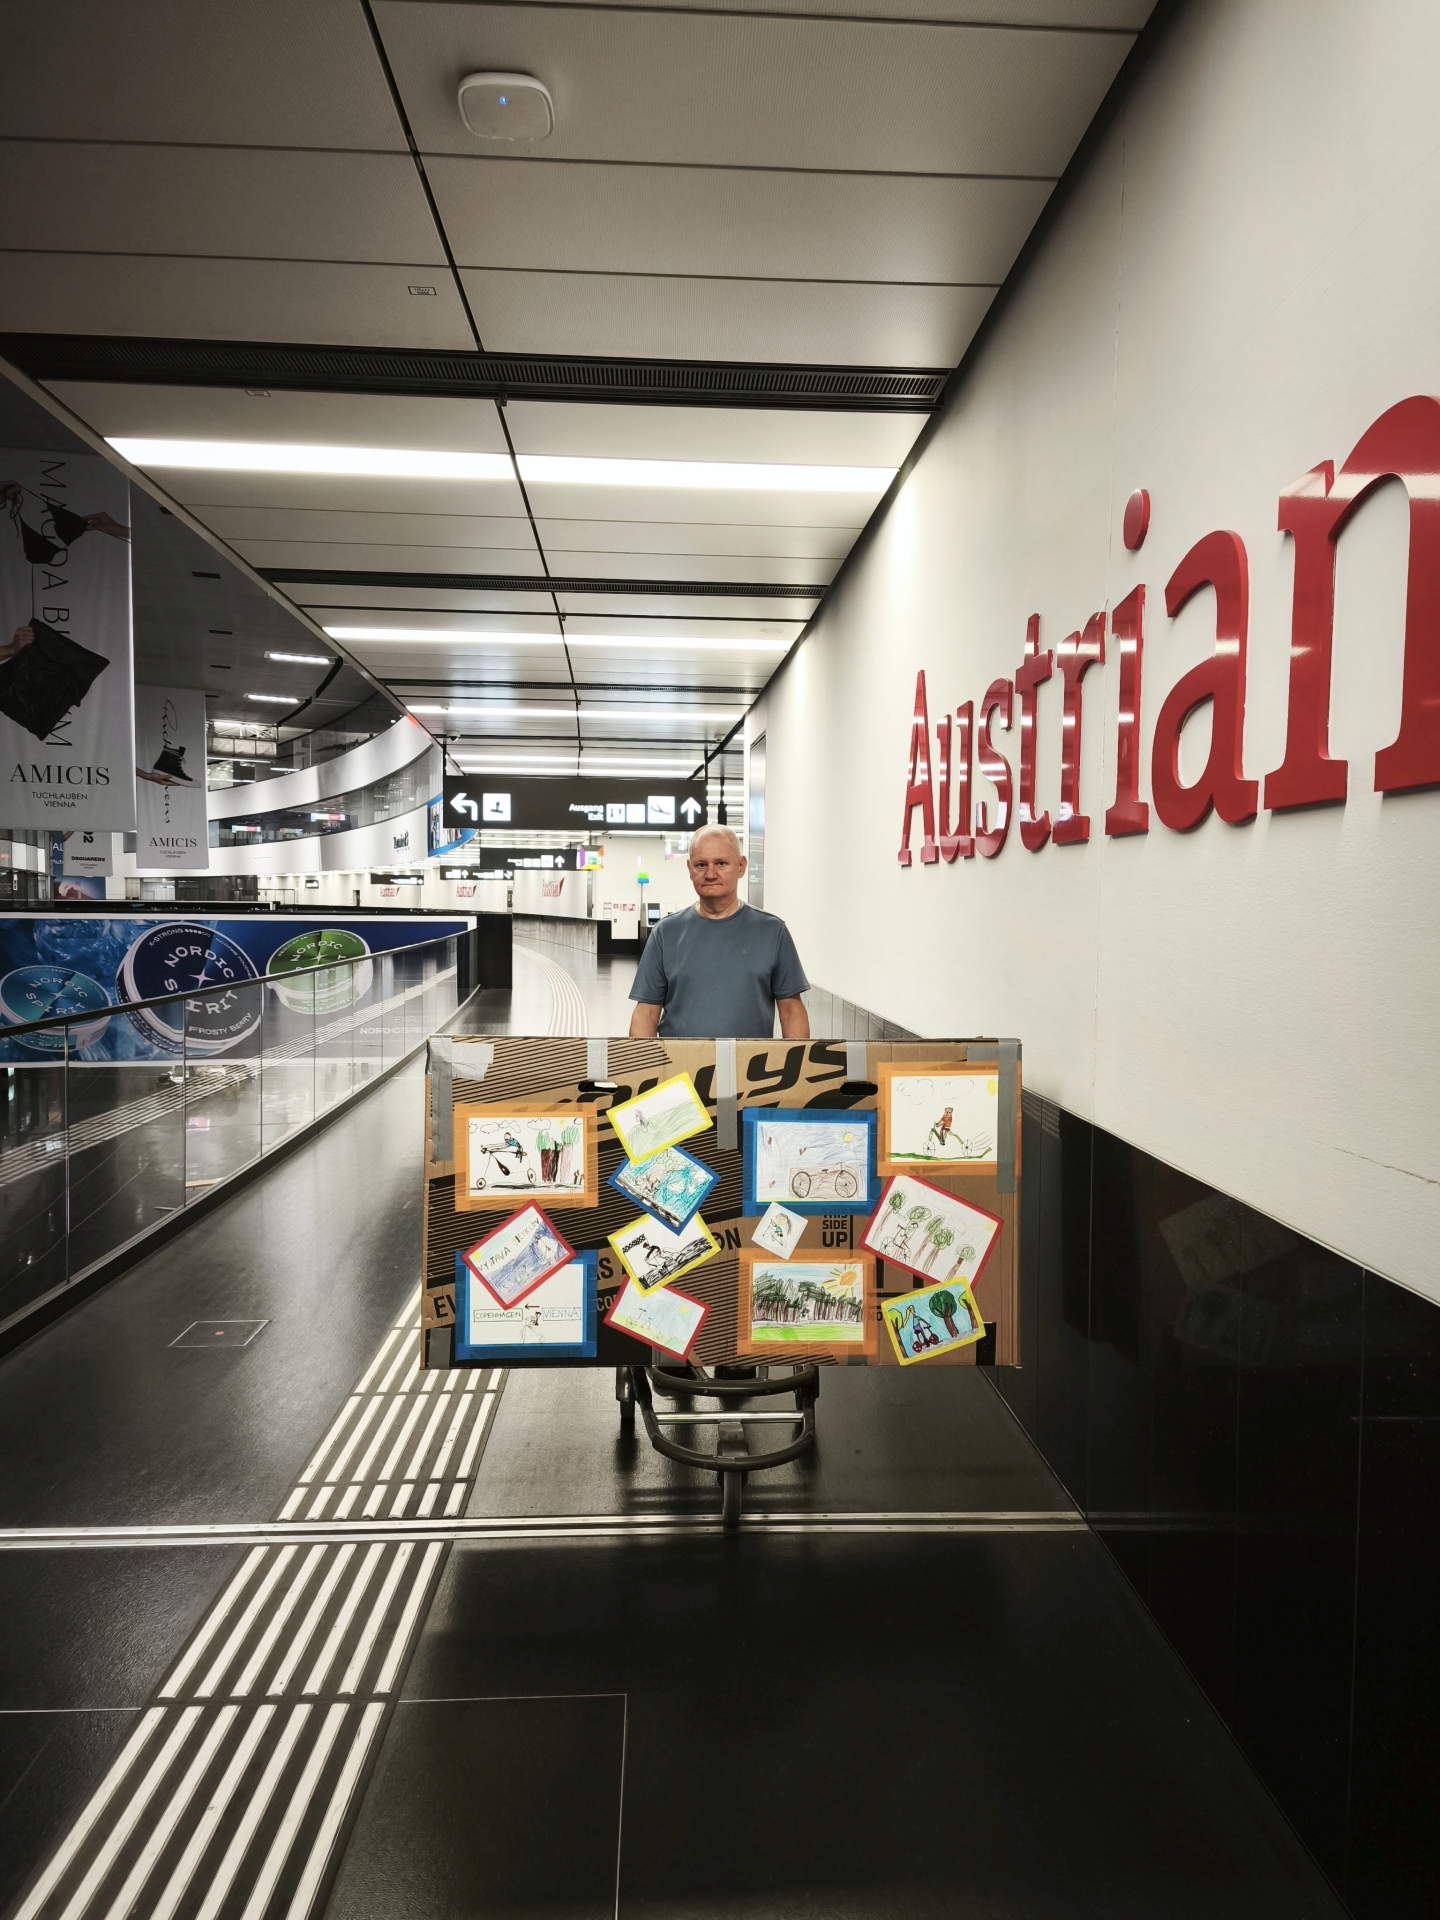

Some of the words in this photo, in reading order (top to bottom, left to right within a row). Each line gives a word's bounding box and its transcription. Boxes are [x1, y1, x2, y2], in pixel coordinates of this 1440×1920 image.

[898, 395, 1440, 867] Austrian
[10, 763, 111, 786] AMICIS
[32, 792, 88, 800] TUCHLAUBEN
[568, 803, 604, 813] Ausgang
[587, 813, 604, 821] Exit
[149, 837, 198, 848] AMICIS
[290, 940, 343, 962] NORDIC
[164, 946, 235, 979] NORDIC
[29, 977, 88, 998] NORDIC
[164, 978, 238, 1014] SIRIT
[25, 992, 85, 1014] SPIRIT
[188, 1025, 228, 1036] FROSTY
[229, 1012, 253, 1032] BERRY
[360, 1027, 400, 1035] NORDIC
[822, 1220, 848, 1230] SIDE
[822, 1231, 848, 1247] UP
[475, 1311, 521, 1320] COPENHAGEN
[543, 1308, 579, 1319] VIENNA
